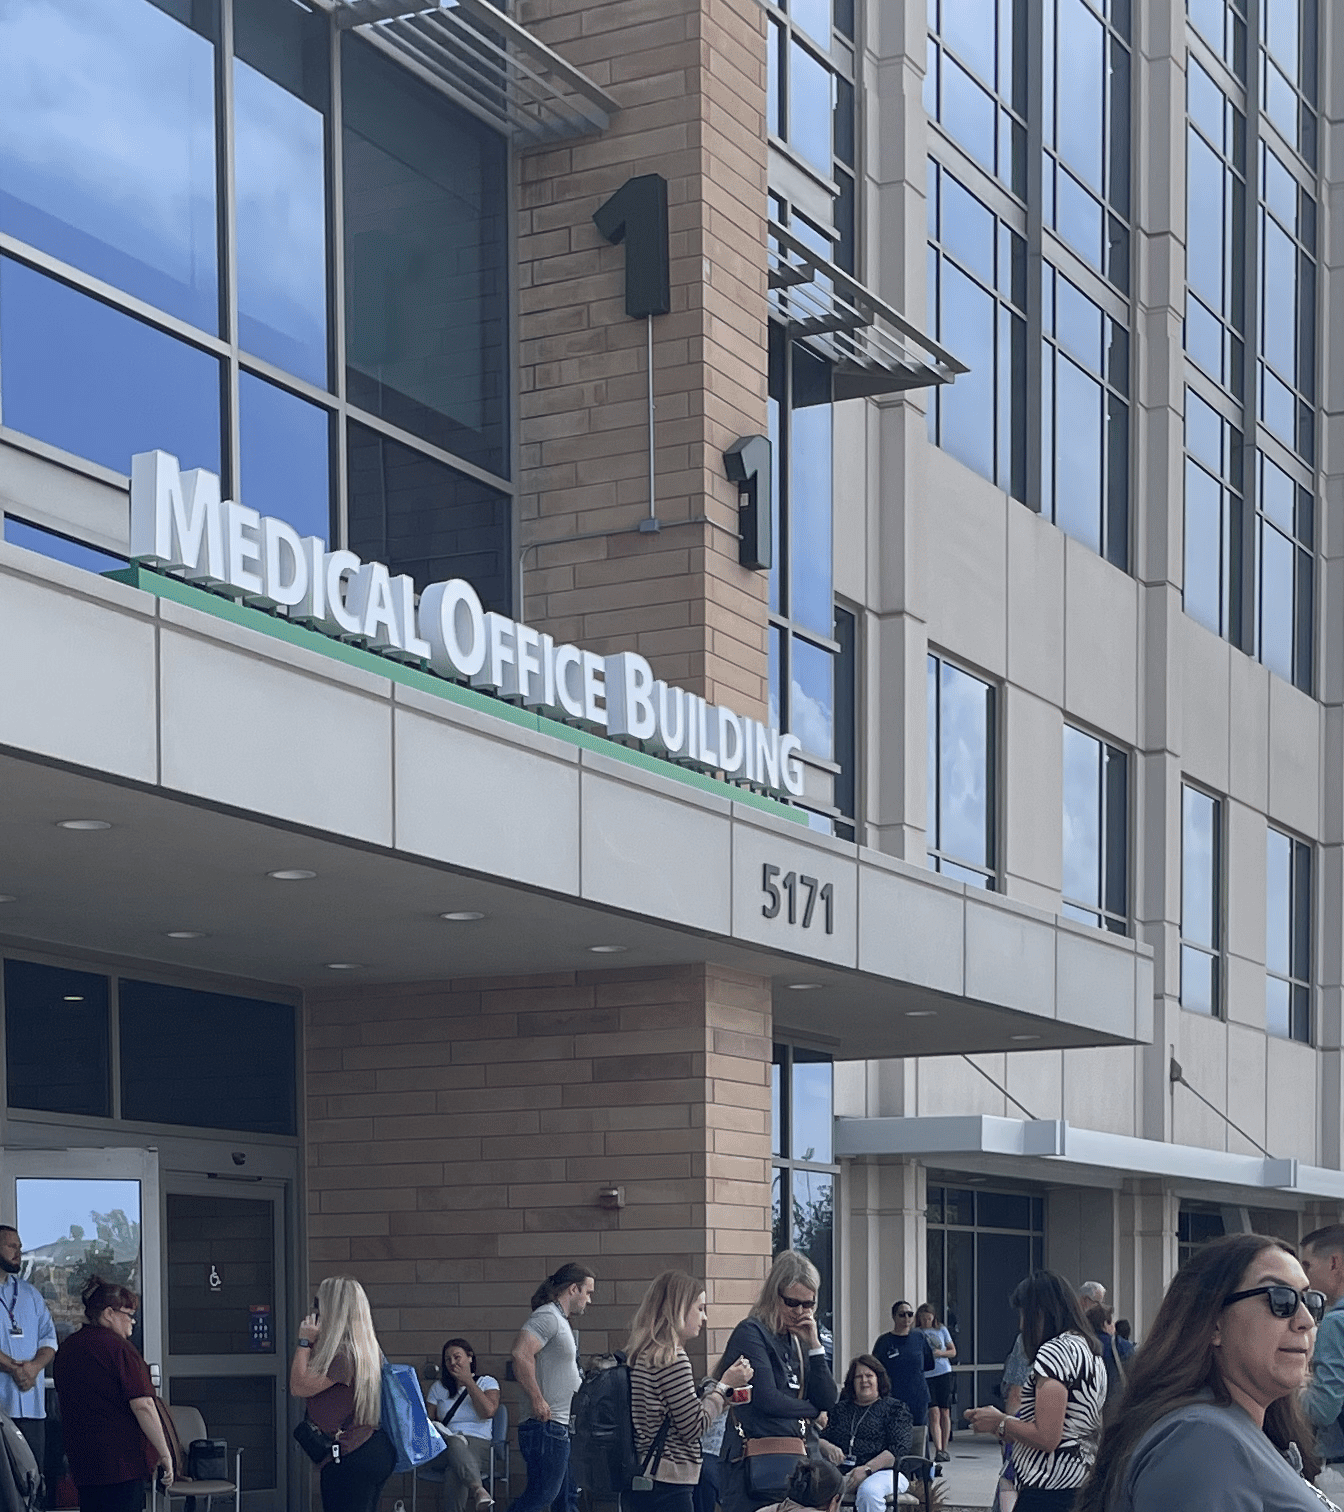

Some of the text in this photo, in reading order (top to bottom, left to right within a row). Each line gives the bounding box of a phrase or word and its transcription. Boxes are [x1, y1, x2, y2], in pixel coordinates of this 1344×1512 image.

[592, 173, 670, 319] 1
[723, 434, 773, 570] 1
[131, 449, 806, 797] MEDICAL OFFICE BUILDING
[761, 862, 834, 935] 5171
